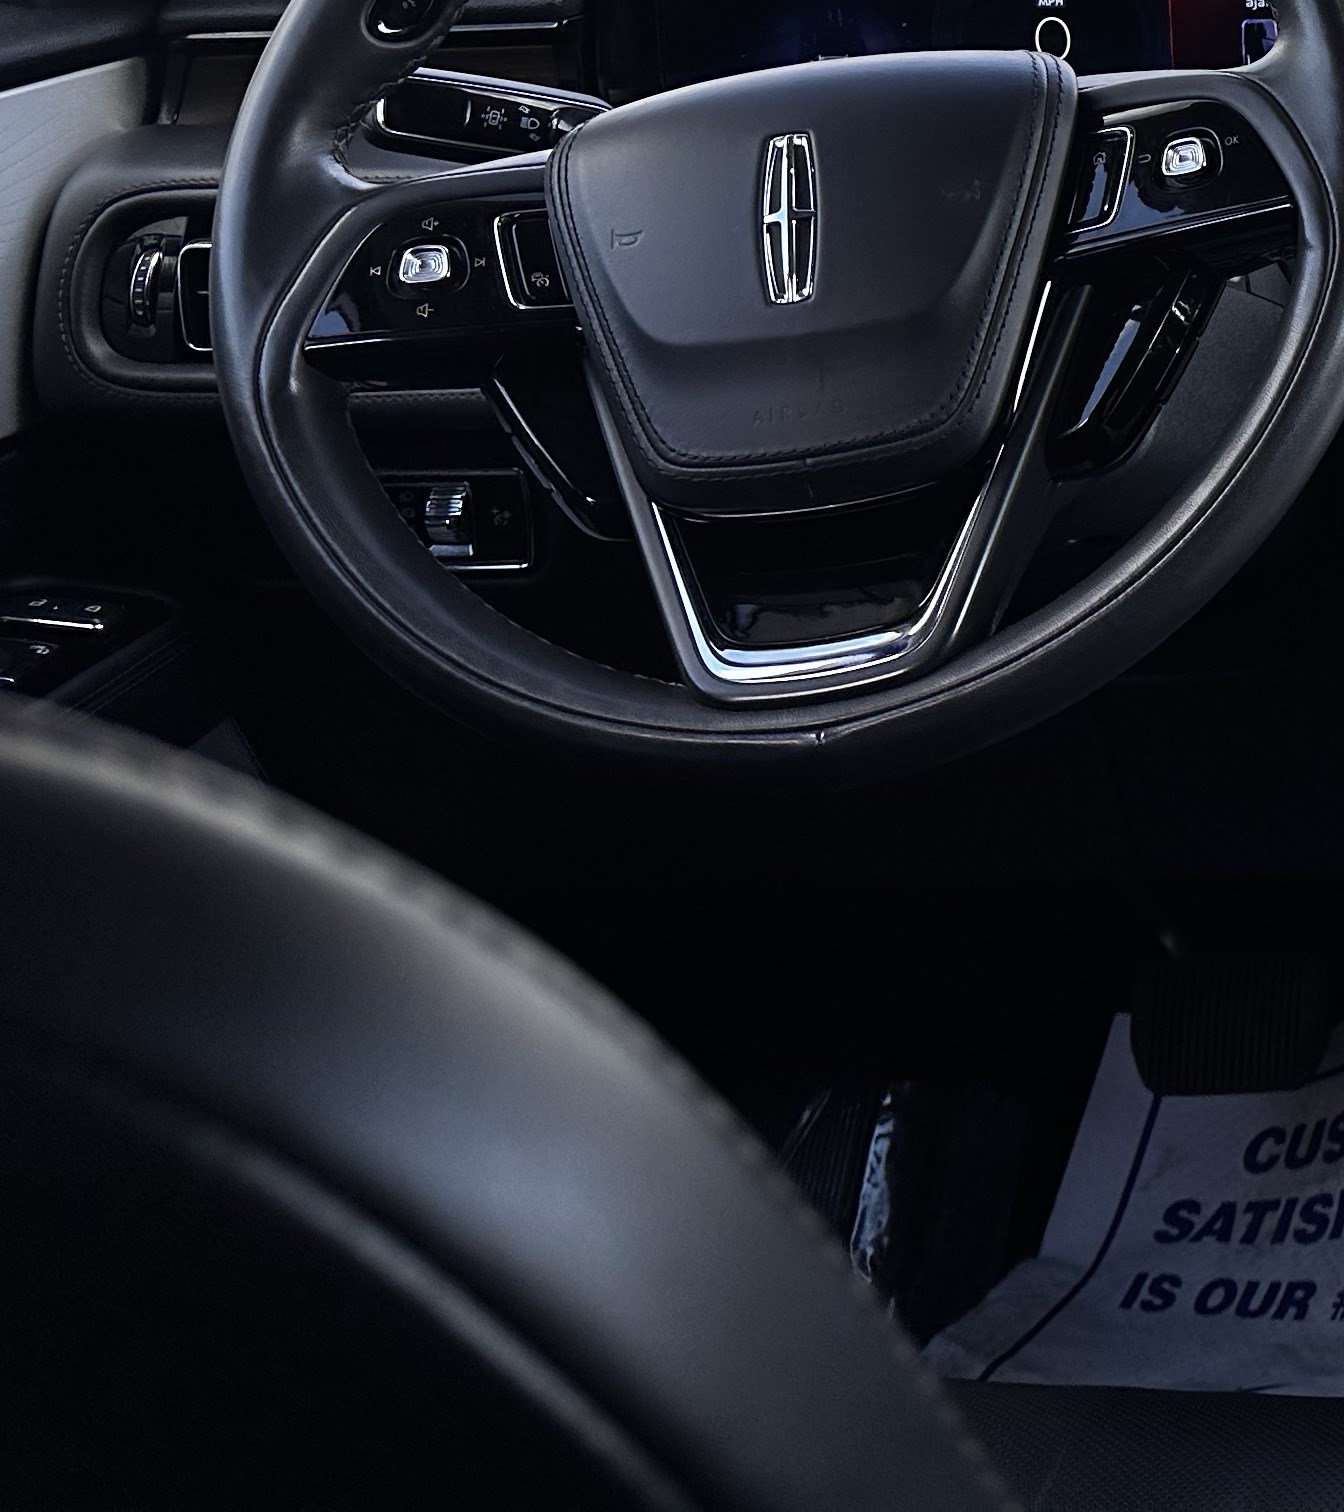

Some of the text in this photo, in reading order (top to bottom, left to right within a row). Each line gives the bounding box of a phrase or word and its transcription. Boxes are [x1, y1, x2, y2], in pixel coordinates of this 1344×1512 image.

[1035, 15, 1071, 61] 0
[1224, 135, 1240, 146] OK
[1120, 1272, 1183, 1311] IS
[1194, 1275, 1317, 1322] OUR
